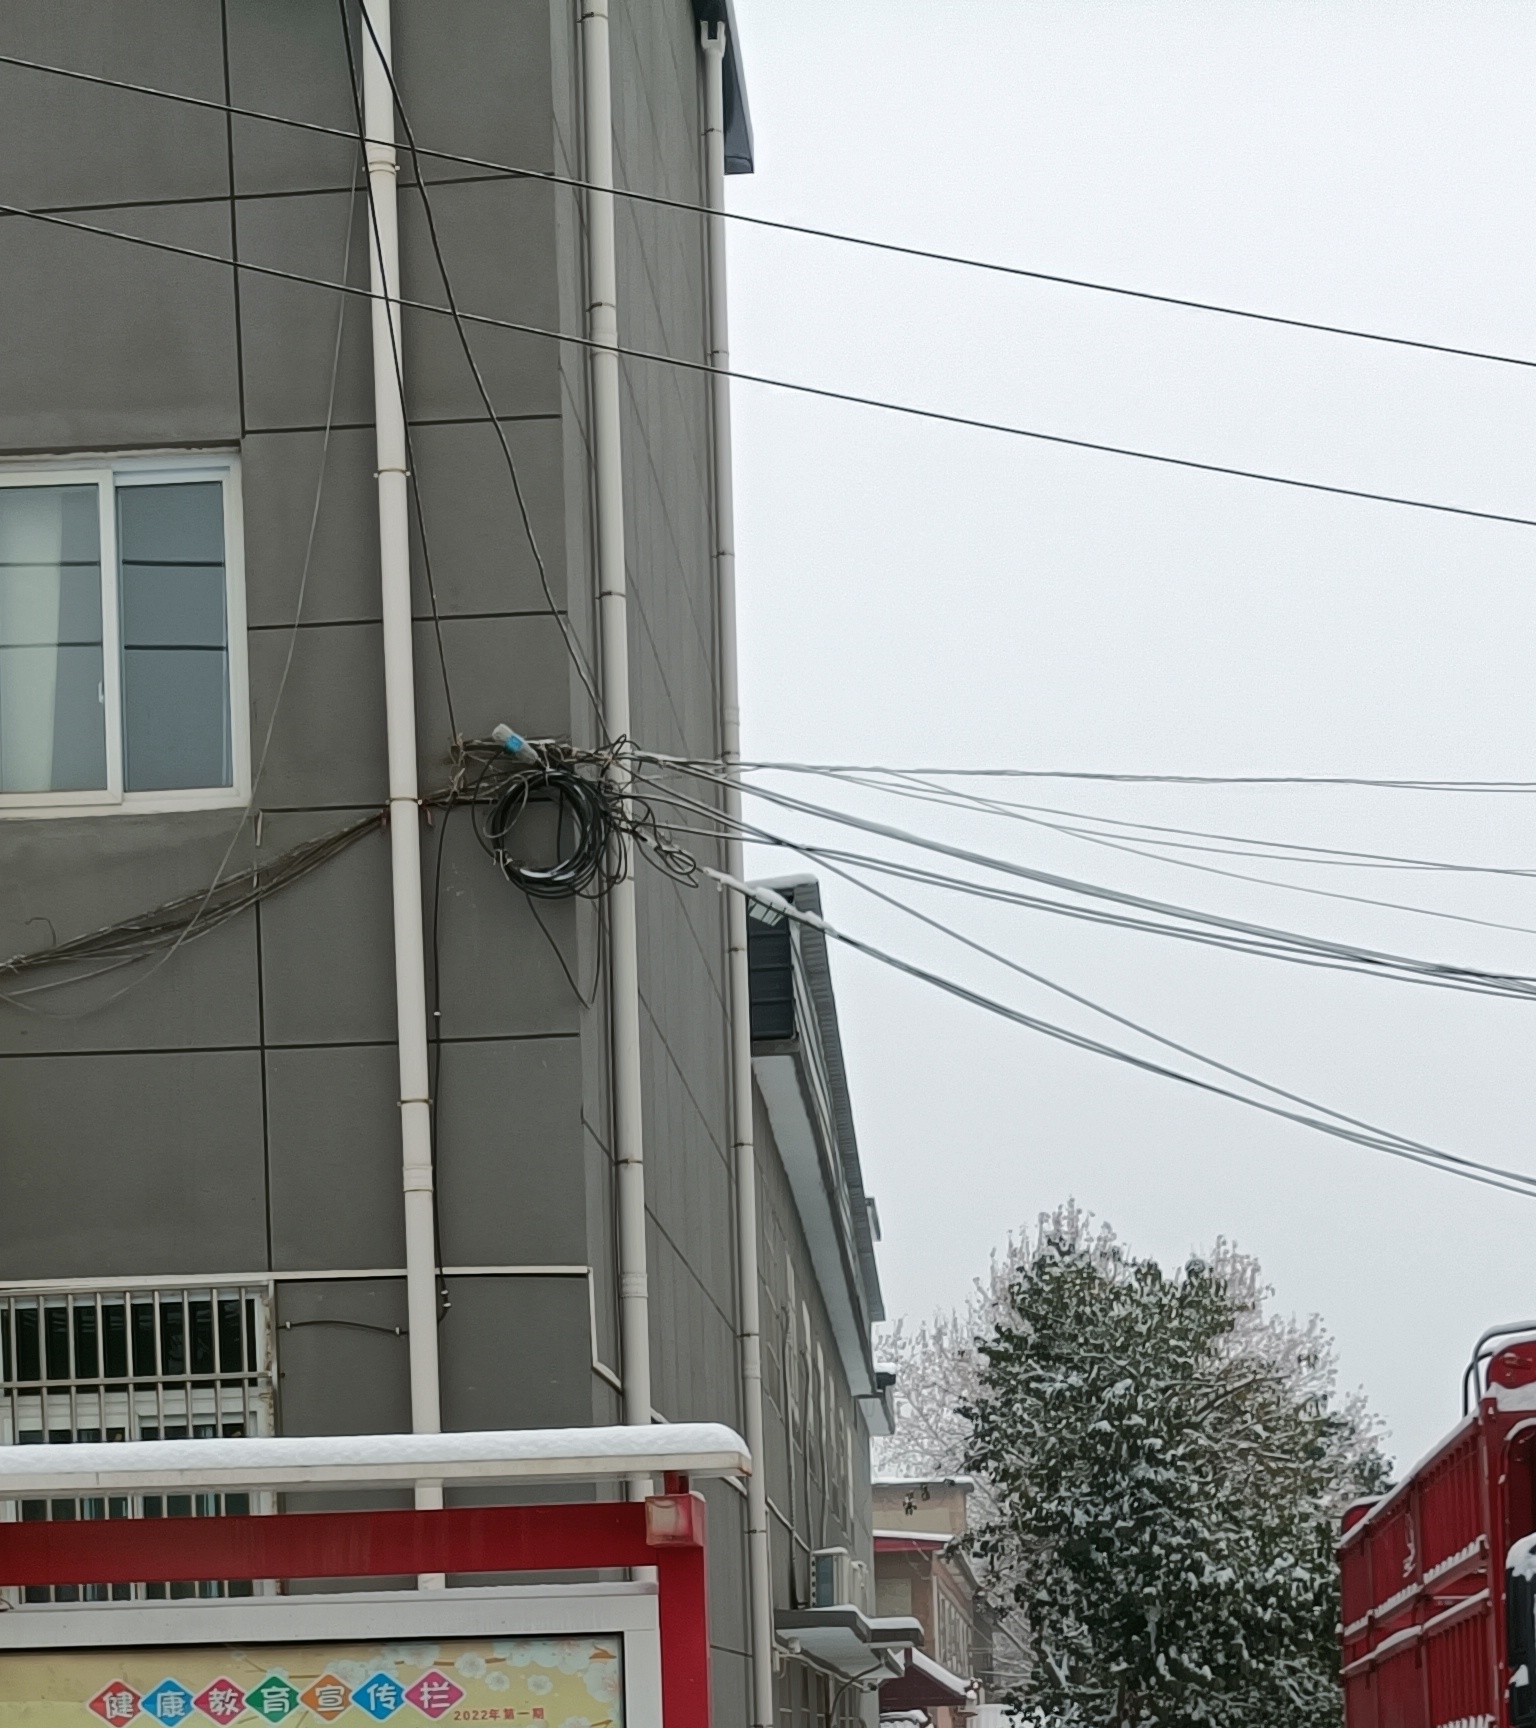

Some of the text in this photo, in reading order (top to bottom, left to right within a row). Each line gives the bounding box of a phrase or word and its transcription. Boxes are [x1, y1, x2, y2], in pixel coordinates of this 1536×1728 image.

[103, 1680, 452, 1720] 健康教育宣传栏
